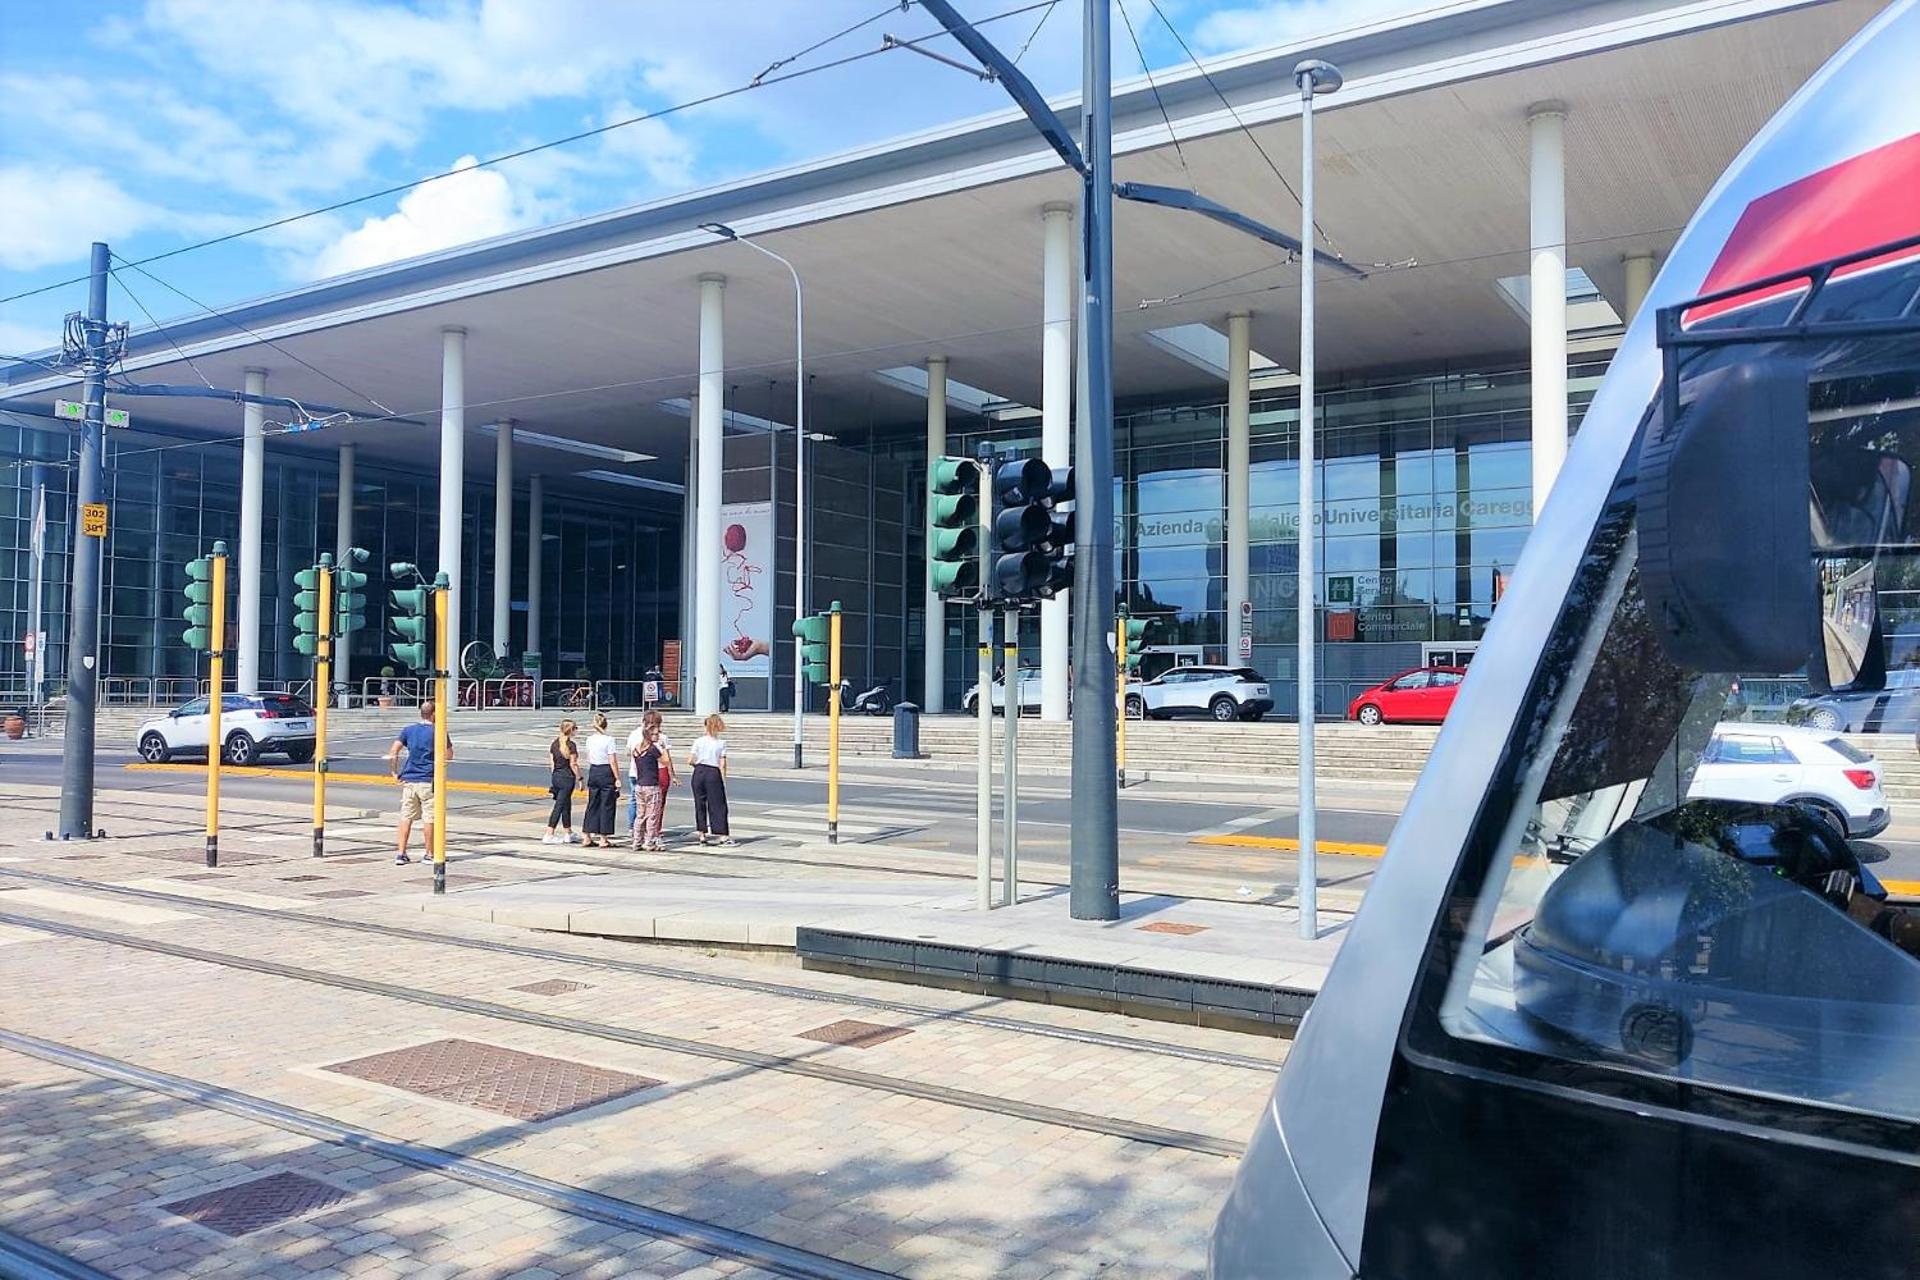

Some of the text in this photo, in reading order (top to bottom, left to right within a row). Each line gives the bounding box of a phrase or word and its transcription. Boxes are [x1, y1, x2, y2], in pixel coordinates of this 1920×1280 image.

[85, 508, 105, 518] 302
[1135, 518, 1204, 537] Azienda
[1324, 501, 1455, 526] Universitaria
[1357, 575, 1393, 586] Centro
[1357, 610, 1393, 621] Centro
[1357, 620, 1427, 632] Commerciale
